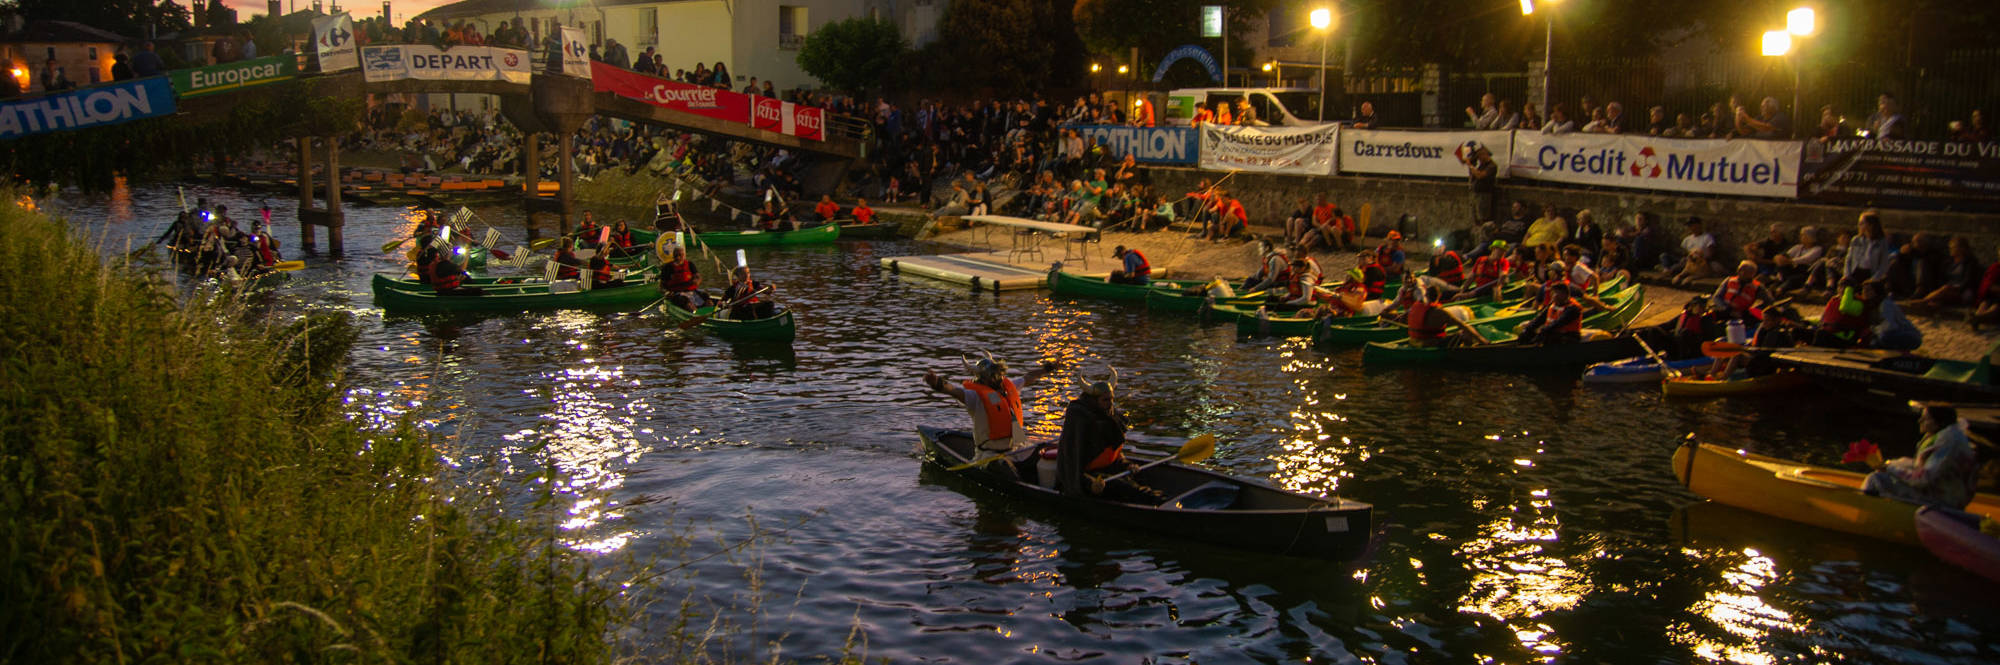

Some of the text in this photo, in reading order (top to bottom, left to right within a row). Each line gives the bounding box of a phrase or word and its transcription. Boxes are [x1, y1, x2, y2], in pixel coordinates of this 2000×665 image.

[413, 54, 493, 69] DEPART
[190, 62, 283, 88] Europcar
[653, 84, 718, 104] Courrier
[757, 103, 820, 129] RTL2 RTL2
[1353, 139, 1443, 160] Carrefour
[1943, 142, 1971, 157] DU
[1977, 141, 2000, 158] VI
[1538, 145, 1627, 176] Crédit
[1667, 153, 1781, 186] Mutuel
